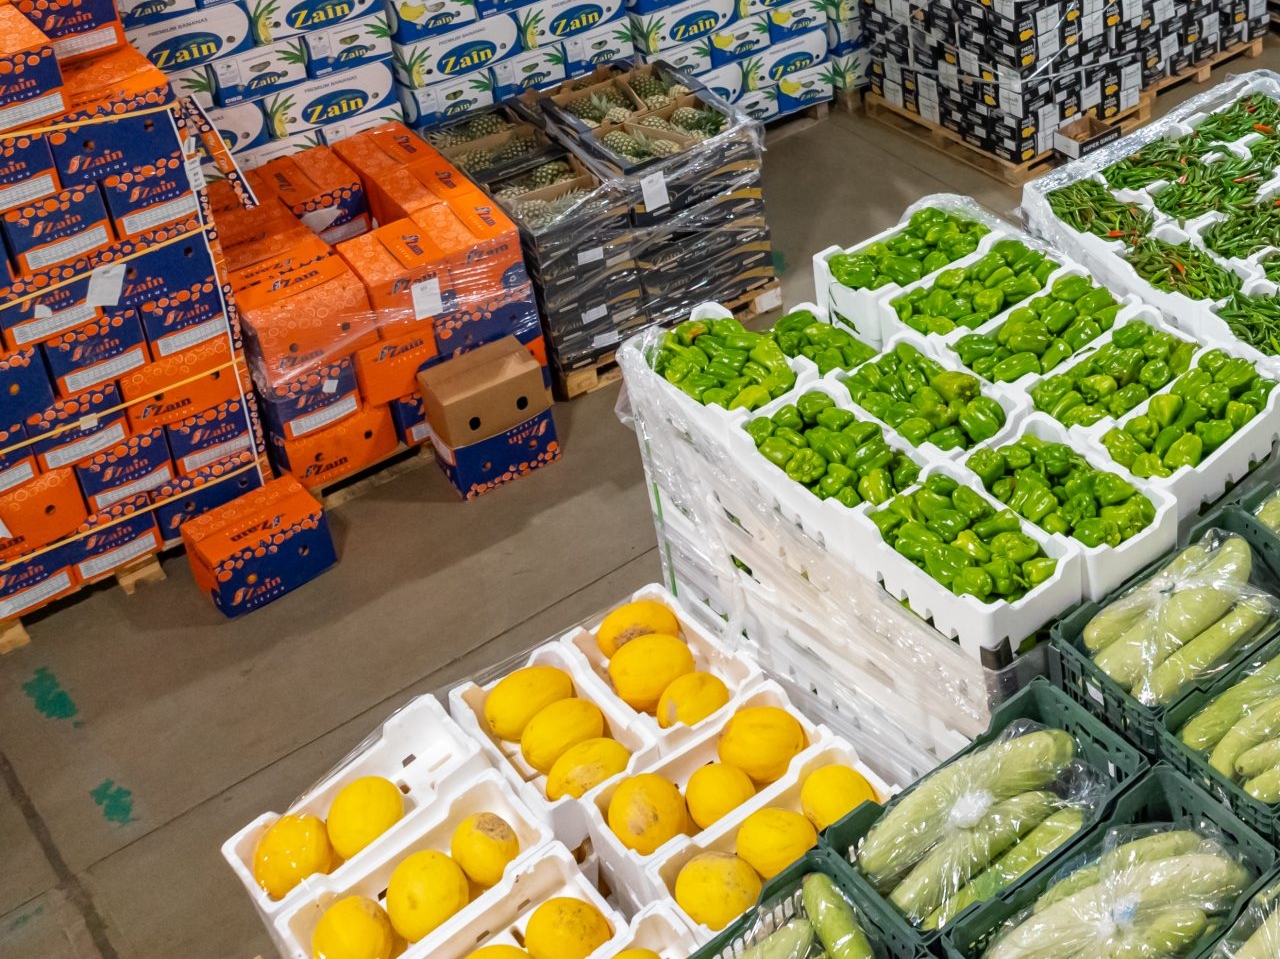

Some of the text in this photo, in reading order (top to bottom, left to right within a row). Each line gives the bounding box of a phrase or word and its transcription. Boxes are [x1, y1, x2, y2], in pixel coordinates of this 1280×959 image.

[133, 1, 165, 18] Zain
[292, 2, 350, 28] Zain
[56, 12, 93, 28] Zain
[426, 15, 454, 29] Zain
[554, 11, 599, 36] Zain
[674, 18, 716, 41] Zain
[152, 40, 217, 68] Zain
[339, 48, 366, 61] Zain
[442, 48, 492, 75] Zain
[590, 52, 615, 65] Zain
[251, 75, 278, 89] Zain
[521, 74, 545, 89] Zain
[308, 97, 364, 124] Zain
[445, 101, 472, 116] Zain
[0, 160, 27, 177] ain
[81, 149, 123, 170] Zain
[140, 180, 176, 199] Zain
[44, 214, 82, 233] Zain
[124, 276, 164, 297] Zain
[281, 270, 320, 288] Zain
[175, 302, 209, 321] Zain
[389, 339, 424, 357] Zain
[154, 397, 191, 415] Zain
[203, 423, 235, 440] Zain
[508, 424, 539, 445] Zain
[113, 458, 149, 477] Zain
[311, 456, 349, 475] Zain
[96, 524, 132, 544] Zain
[8, 564, 44, 584] Zain
[244, 577, 282, 602] Zain
